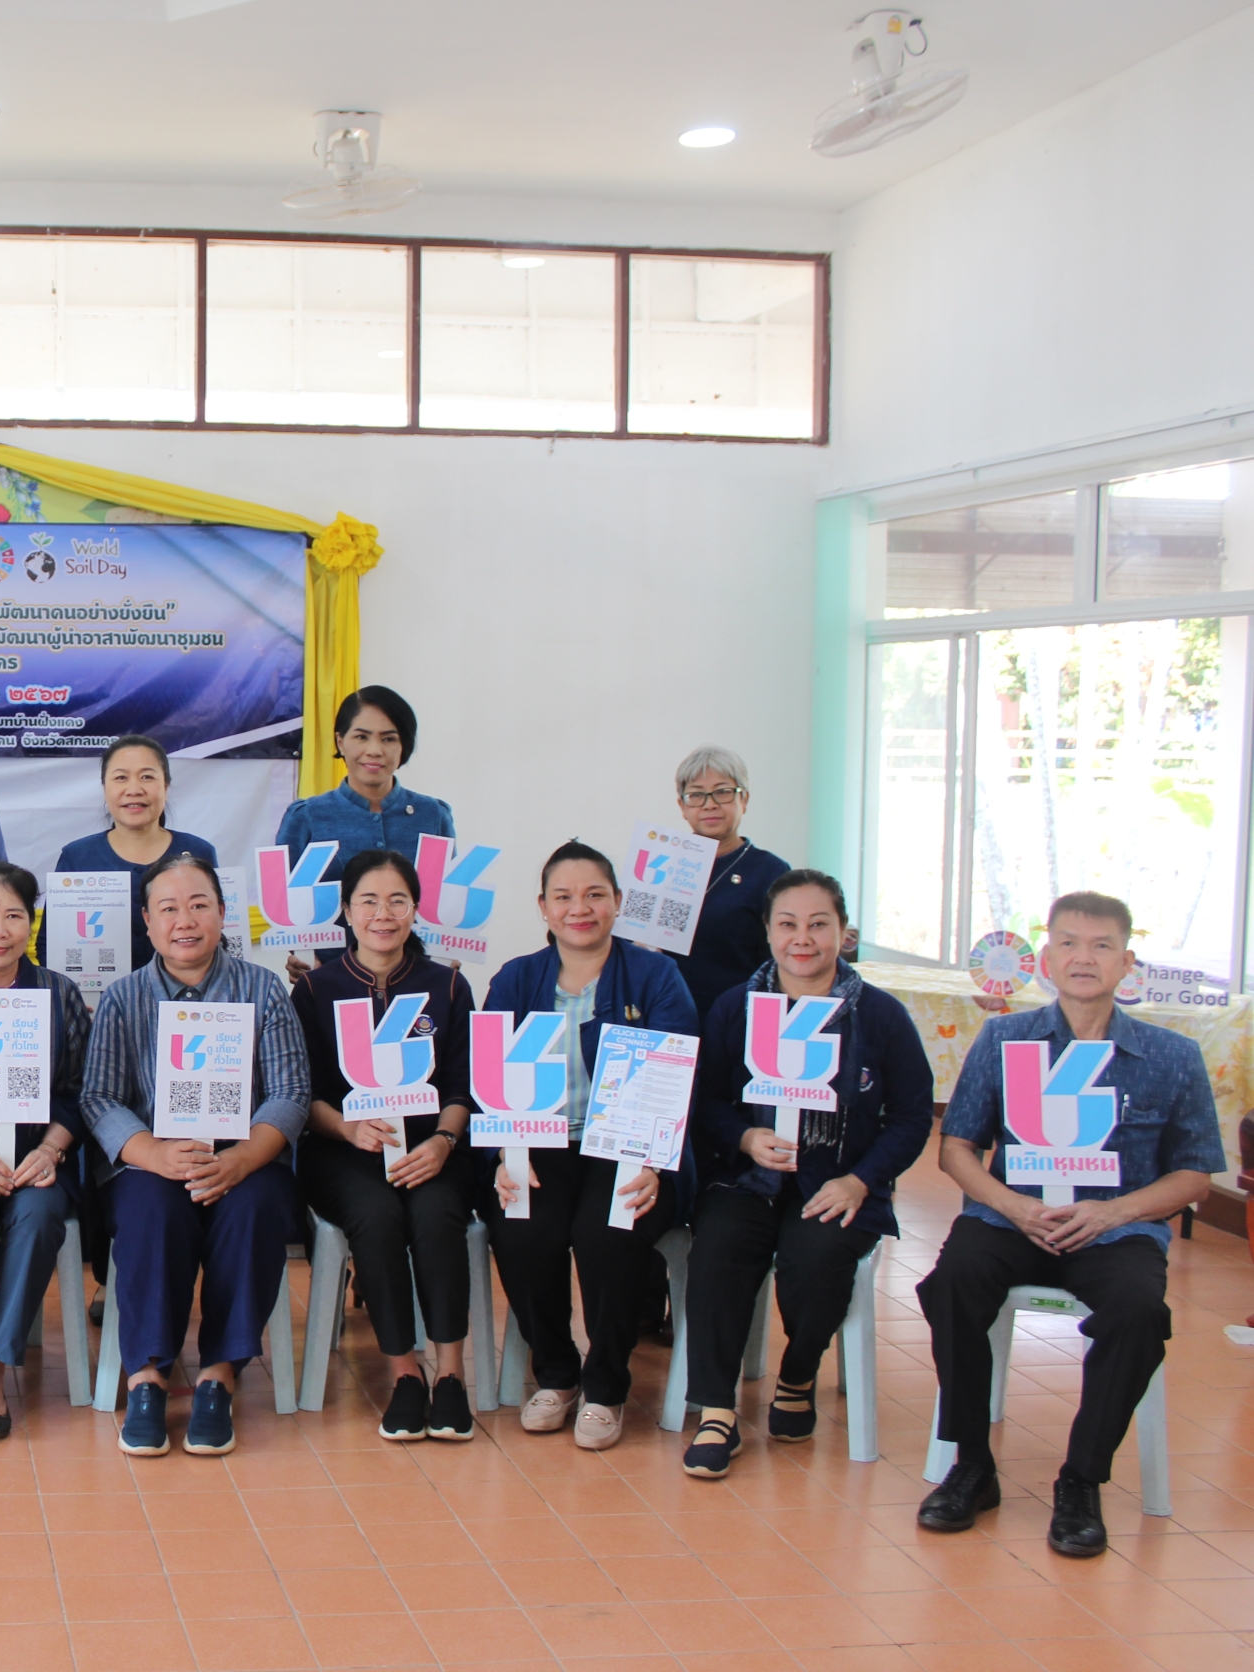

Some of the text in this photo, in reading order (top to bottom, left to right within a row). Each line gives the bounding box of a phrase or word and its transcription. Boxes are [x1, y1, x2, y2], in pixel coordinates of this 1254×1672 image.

[71, 538, 120, 557] World
[66, 558, 128, 580] Soil Day
[8, 686, 69, 703] ๒๕๖๗
[264, 930, 343, 948] คลิกชุมชน
[1146, 989, 1229, 1007] for Good
[12, 1018, 39, 1031] เรียนรู้
[3, 1028, 34, 1041] ดู เที่ยว
[215, 1032, 243, 1045] เรียนรู้
[611, 1027, 649, 1041] CLICK TO
[616, 1036, 657, 1049] CONNECT
[11, 1039, 39, 1051] ทั่วไทย
[206, 1042, 237, 1055] ดู เที่ยว
[214, 1053, 242, 1065] ทั่วไทย
[748, 1080, 831, 1102] คลิกชุมชน
[347, 1091, 435, 1112] คลิกชุมชน
[472, 1115, 567, 1139] คลิกชุมชน
[1008, 1151, 1116, 1177] คลิกชุมชน
